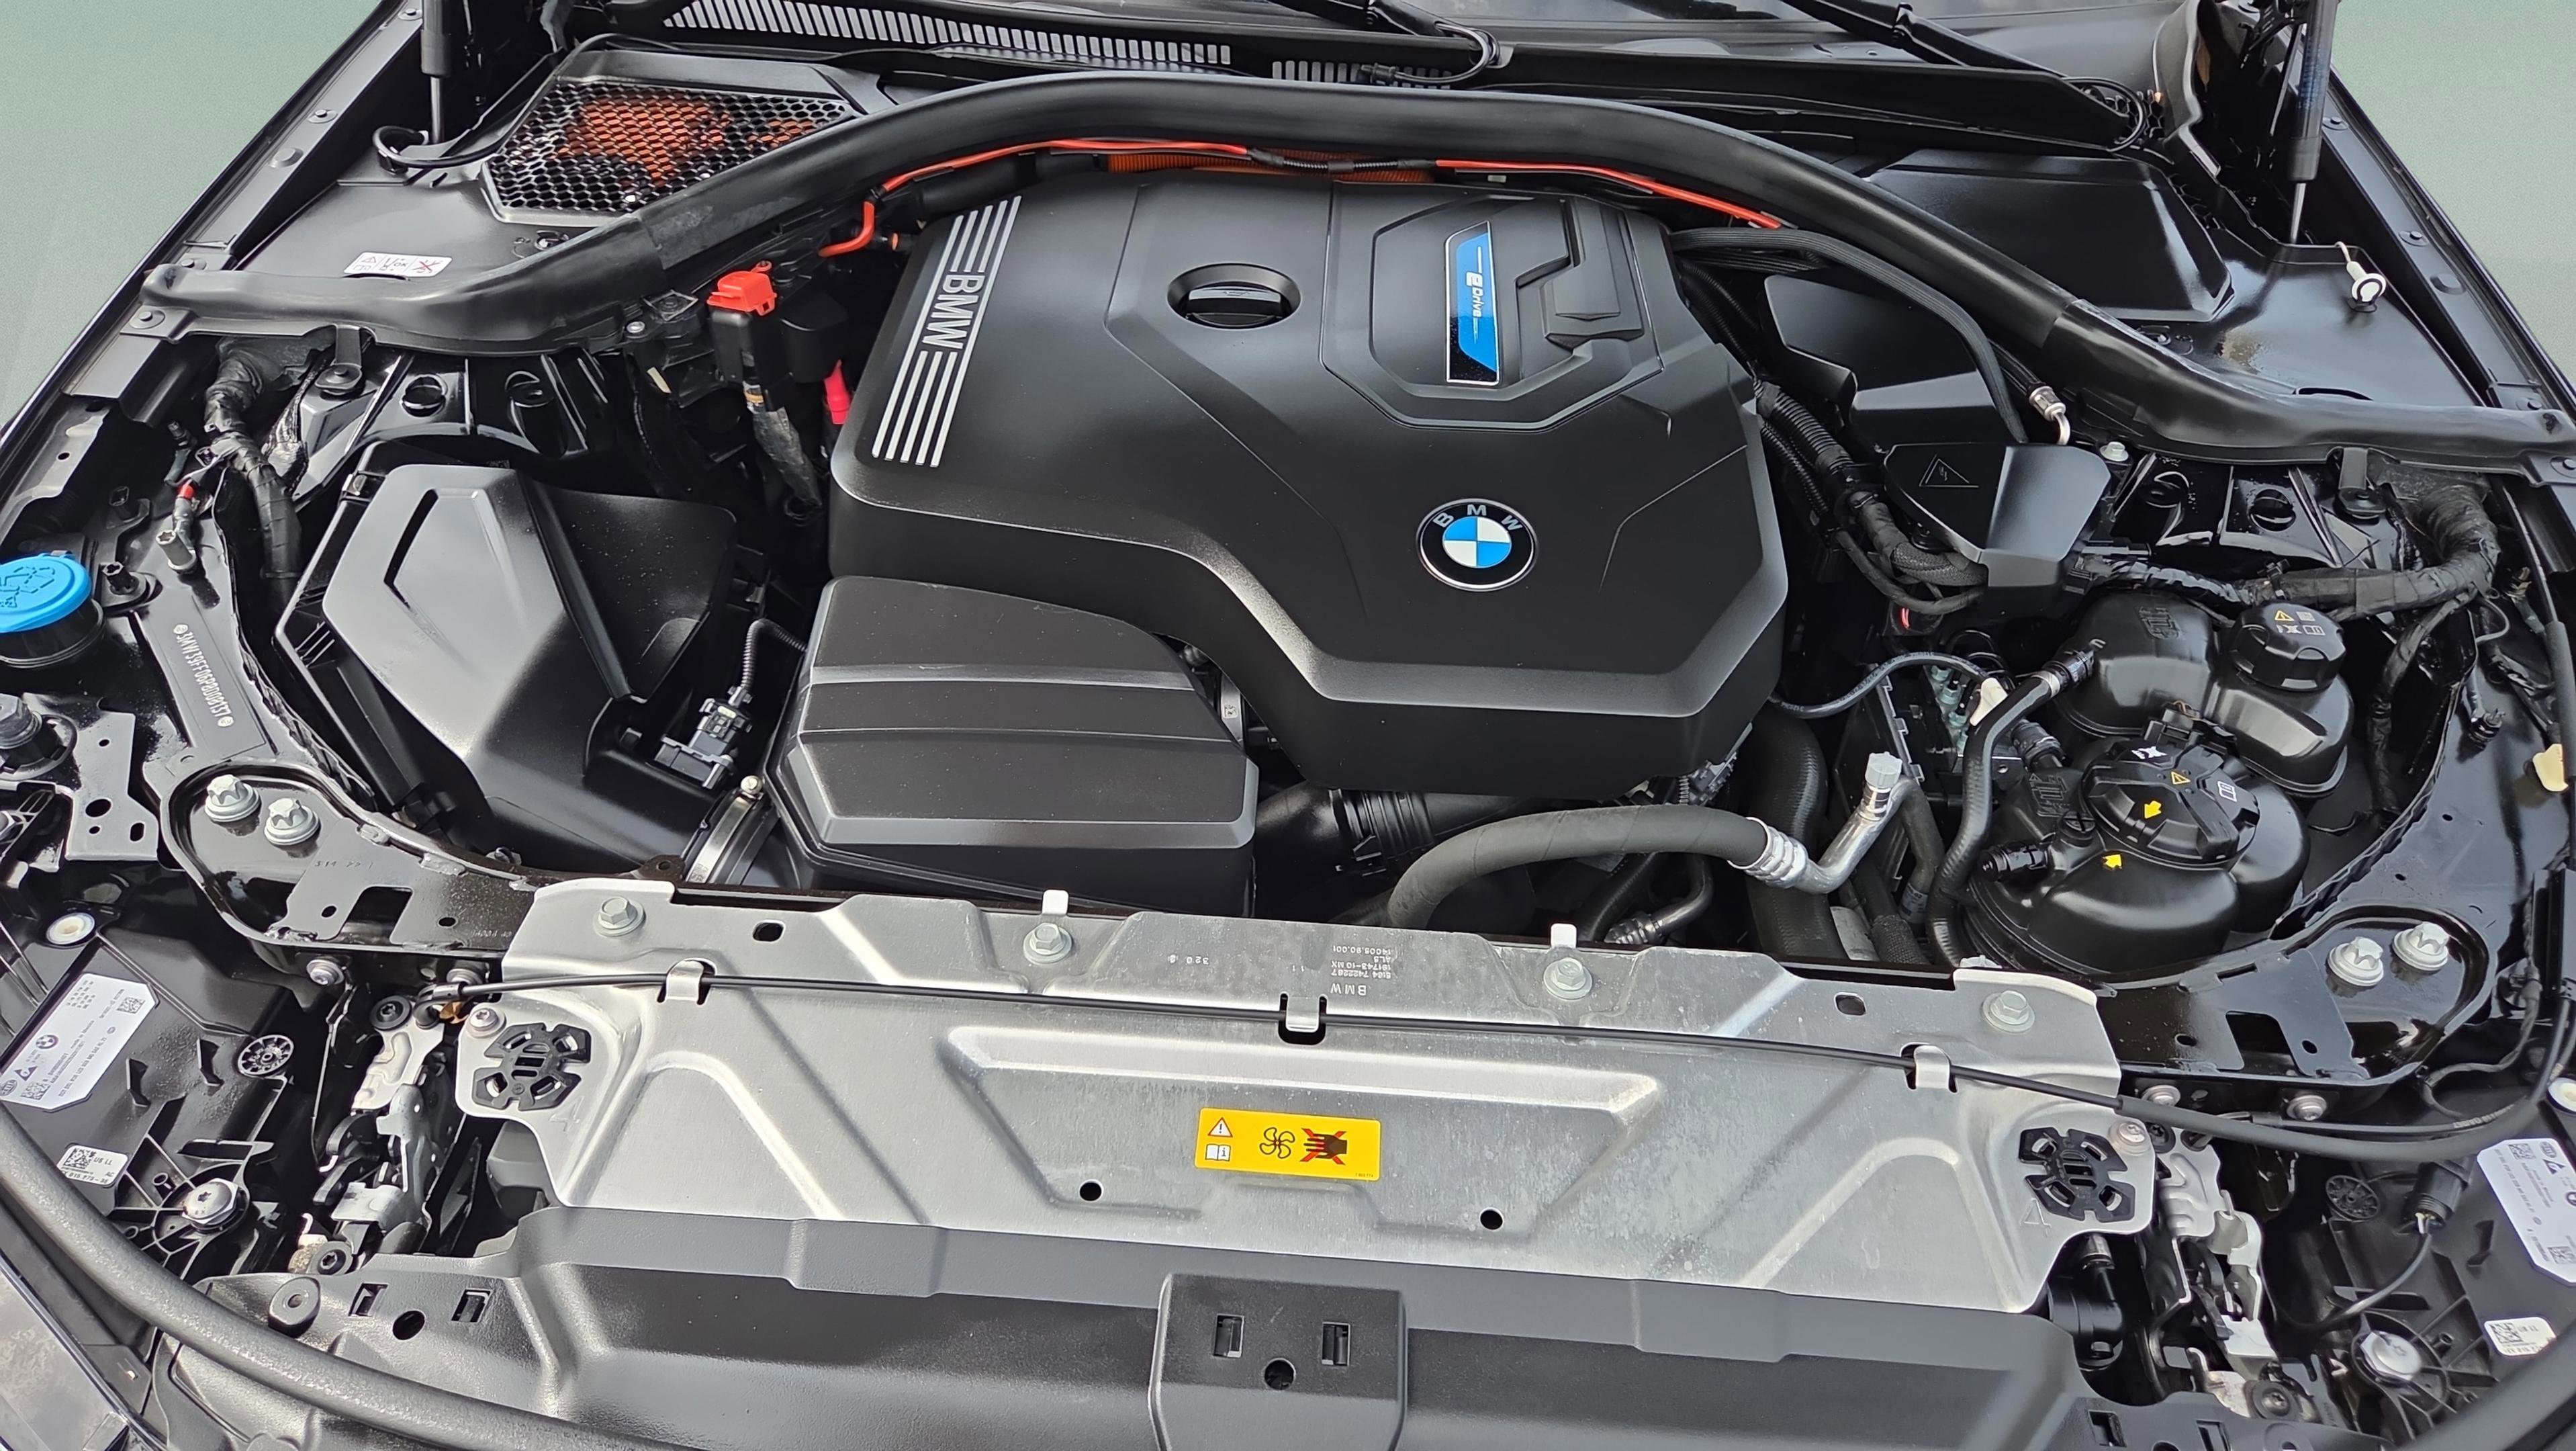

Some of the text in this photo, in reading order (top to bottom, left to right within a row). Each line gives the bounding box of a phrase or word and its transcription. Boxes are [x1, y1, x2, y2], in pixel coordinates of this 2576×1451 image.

[922, 275, 986, 349] BMW
[1432, 504, 1522, 531] BMW
[1330, 983, 1367, 996] BMW
